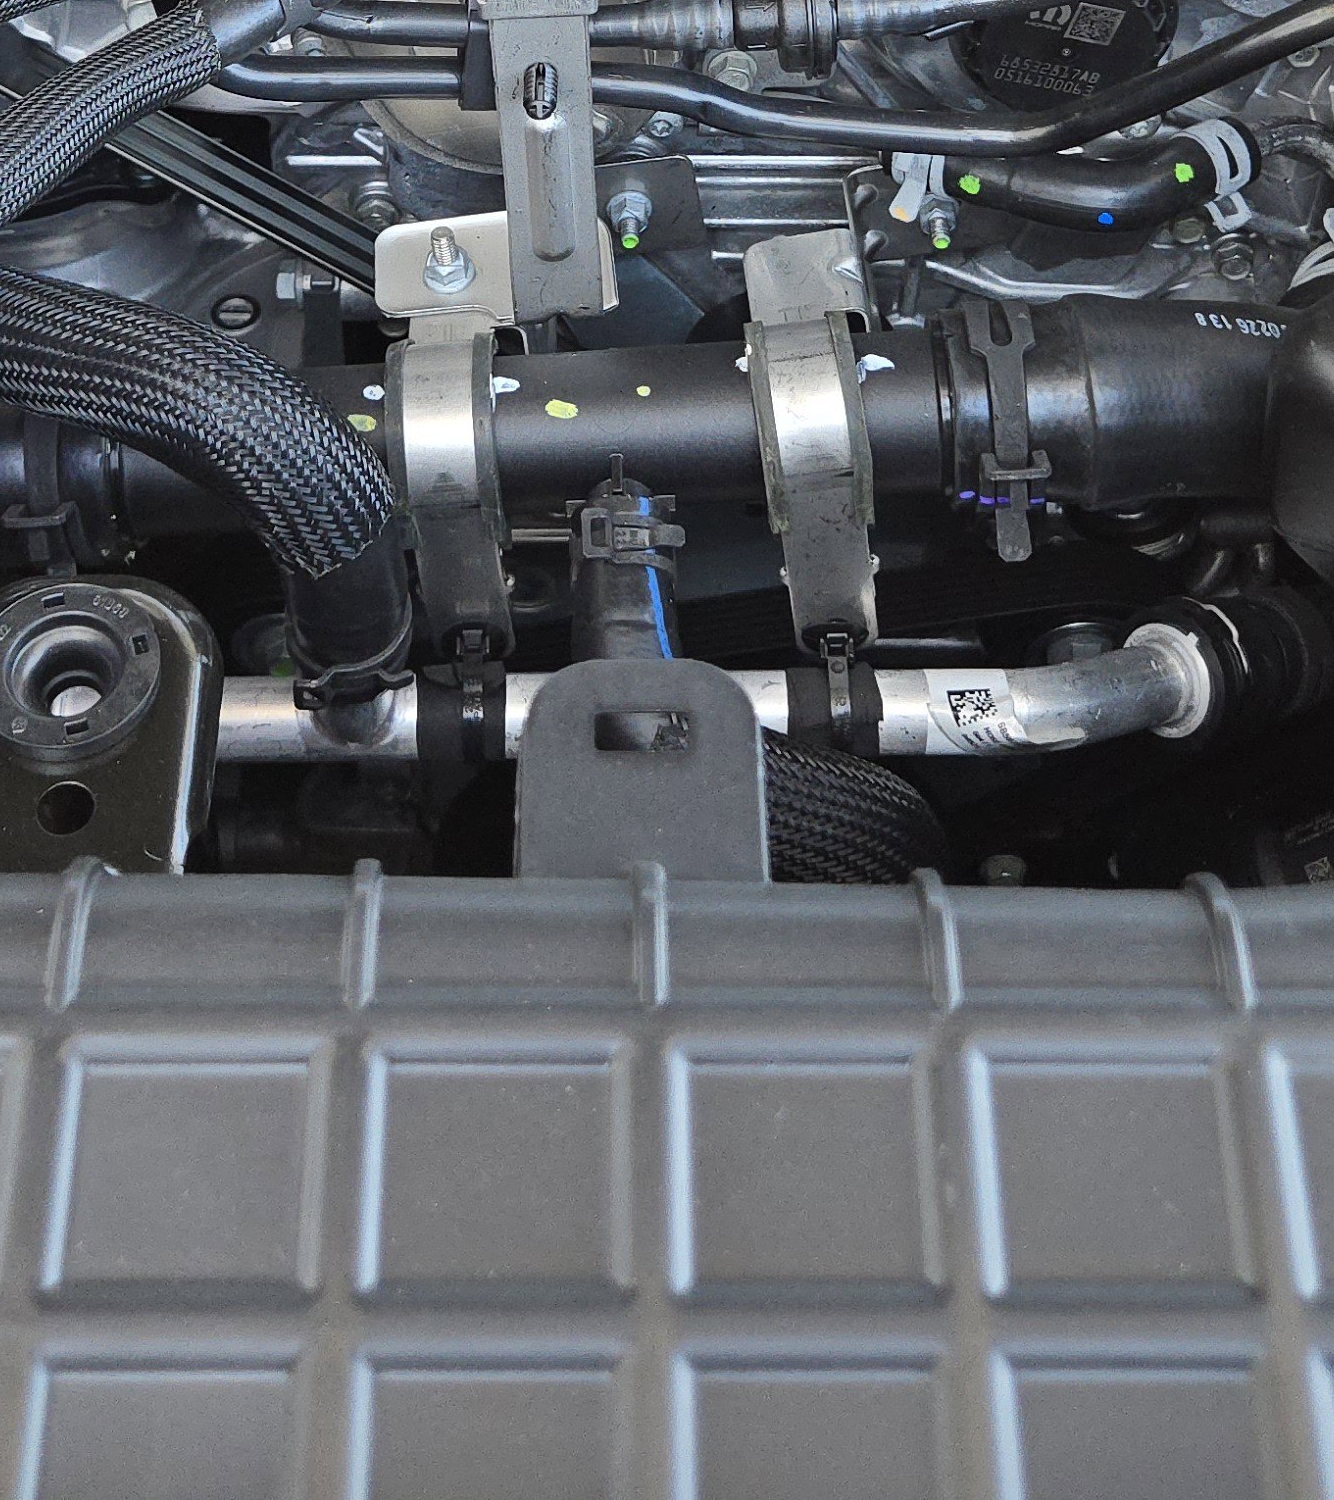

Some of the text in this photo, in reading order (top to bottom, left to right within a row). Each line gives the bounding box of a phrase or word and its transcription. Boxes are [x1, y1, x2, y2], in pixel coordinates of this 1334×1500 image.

[993, 67, 1095, 97] 0516100063
[999, 54, 1101, 84] 68532817AB
[1235, 317, 1286, 339] 0226
